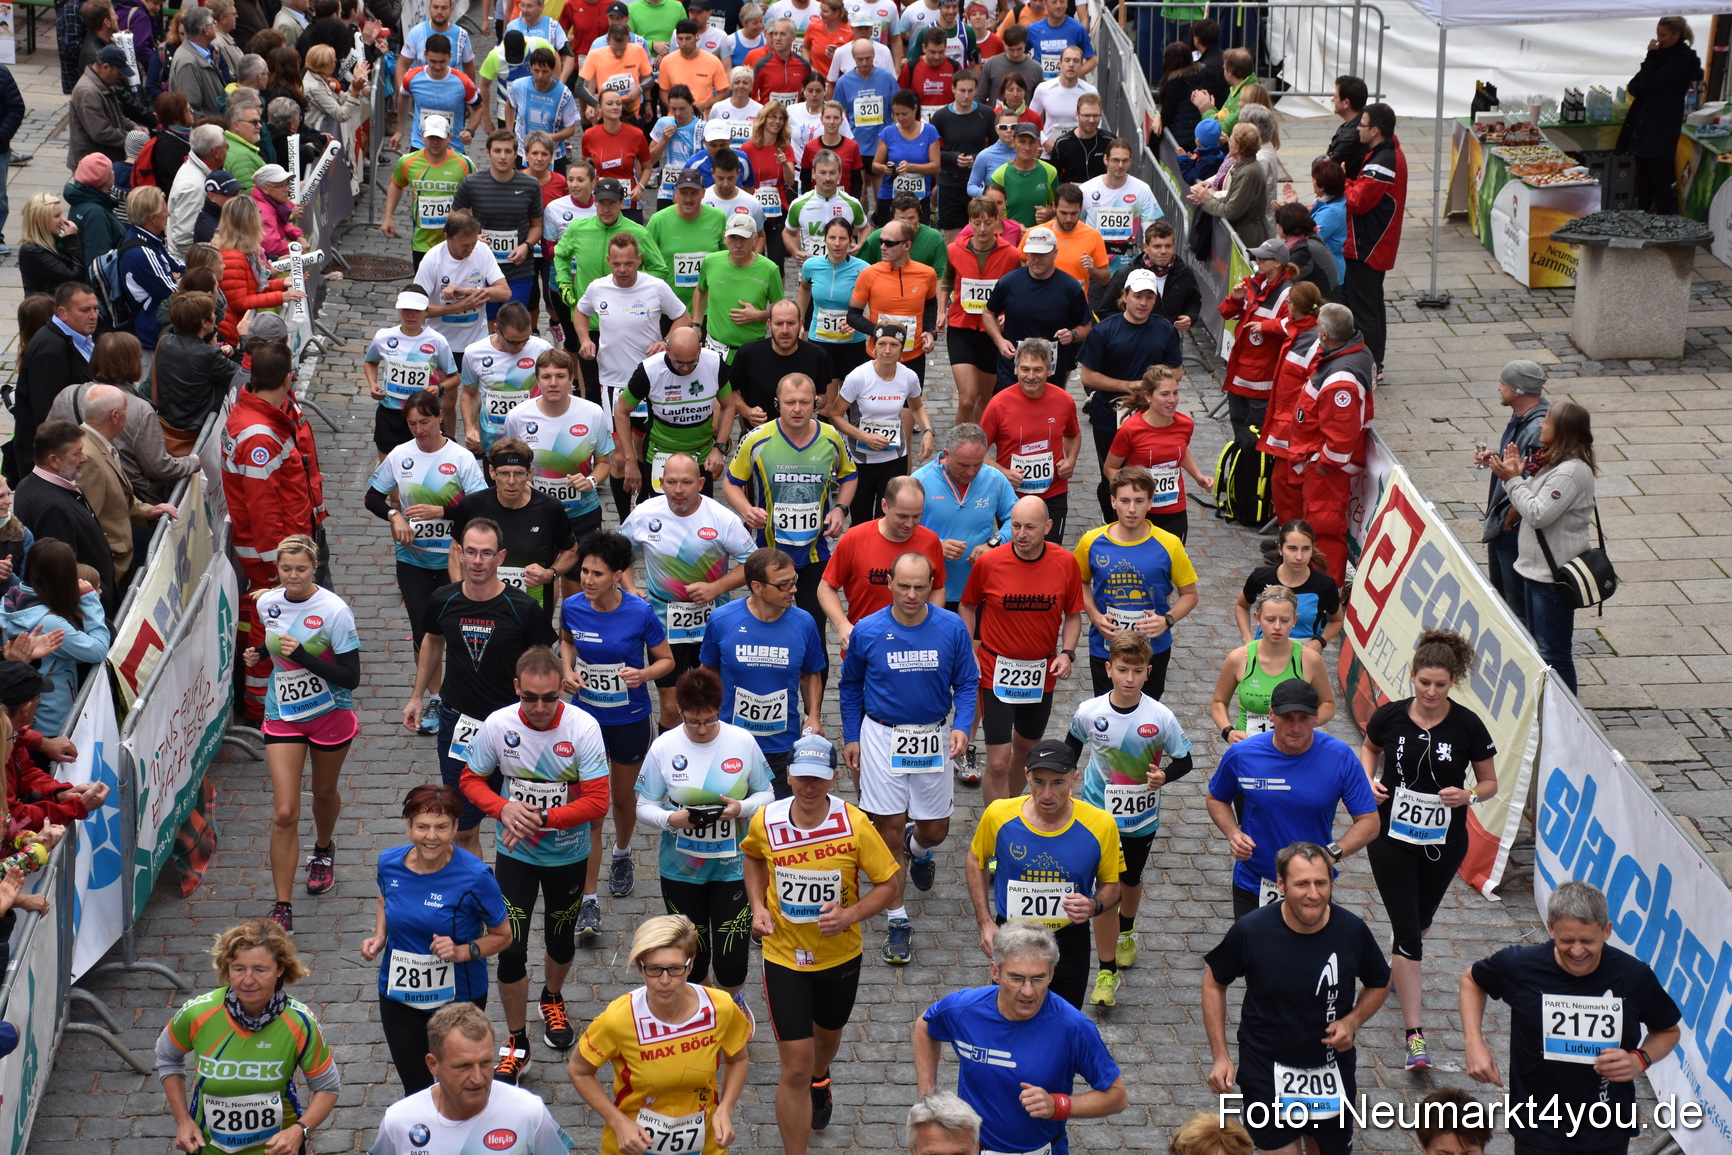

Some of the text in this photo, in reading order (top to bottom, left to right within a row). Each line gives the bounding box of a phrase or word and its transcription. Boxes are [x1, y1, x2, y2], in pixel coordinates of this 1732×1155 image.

[1040, 40, 1067, 49] HUBER
[1044, 61, 1060, 72] 254
[606, 79, 631, 92] 2587
[860, 103, 879, 116] 320
[730, 126, 750, 138] 646
[316, 158, 333, 179] BMW
[665, 171, 681, 184] 257
[413, 181, 460, 192] BOCK
[896, 178, 922, 192] 2359
[756, 194, 780, 206] 2553
[422, 203, 451, 217] 2794
[1101, 215, 1130, 228] 2692
[486, 238, 515, 252] 2601
[812, 244, 827, 256] 21
[292, 256, 302, 279] BMW
[678, 261, 701, 274] 274
[969, 288, 993, 301] 120
[391, 368, 426, 386] 2182
[491, 400, 521, 415] 239
[662, 404, 710, 416] Laufteam
[673, 415, 702, 423] Fürth
[1015, 463, 1051, 480] 2206
[773, 473, 824, 484] BOCK
[779, 513, 818, 530] 3116
[415, 521, 454, 539] 2394
[459, 618, 496, 627] FINISHER
[672, 608, 712, 628] 2256
[462, 625, 492, 634] BRAVEHEART
[736, 645, 790, 660] HUBER
[886, 649, 939, 663] HUBER
[746, 655, 788, 664] TECHNOLOGY
[899, 660, 938, 668] TECHNOLOGY
[996, 660, 1015, 668] PARTL
[1368, 627, 1412, 700] PFLA
[580, 670, 620, 692] 2551
[998, 668, 1043, 687] 2239
[279, 676, 324, 702] 2528
[1004, 688, 1032, 698] Michael
[588, 692, 614, 702] Claudia
[737, 692, 754, 700] PARTL
[290, 701, 319, 713] Yvonne
[739, 700, 782, 721] 2672
[743, 721, 775, 731] Matthias
[893, 728, 912, 736] PARTL
[896, 735, 940, 755] 2310
[503, 749, 521, 757] PARTL
[724, 762, 742, 770] Hervis
[902, 757, 933, 767] Bernhard
[512, 781, 558, 794] PARTL Neumarkt
[1111, 792, 1156, 815] 2466
[1396, 801, 1446, 827] 2670
[1408, 825, 1429, 839] Katja
[686, 840, 723, 852] ALEX
[772, 842, 857, 867] MAX BÖGL
[776, 872, 830, 882] PARTL Neumarkt
[781, 880, 836, 903] 2705
[1008, 886, 1063, 894] PARTL Neumarkt
[430, 893, 443, 901] TSG
[1020, 895, 1062, 917] 207
[392, 955, 443, 967] PARTL Neumarkt
[395, 965, 449, 989] 2817
[404, 992, 440, 1003] Barbara
[1544, 1000, 1610, 1011] PARTL Neumarkt
[1551, 1011, 1616, 1039] 2173
[640, 1034, 718, 1062] MAX BÖGL
[1565, 1042, 1601, 1056] Ludwig
[198, 1056, 285, 1081] BOCK
[1282, 1070, 1338, 1096] 2209
[205, 1098, 269, 1108] PARTL Neumarkt
[211, 1108, 277, 1132] 2808
[639, 1112, 694, 1130] PARTL Neumarkt
[226, 1133, 261, 1146] Margit
[488, 1134, 514, 1145] Hervis
[643, 1126, 700, 1153] 2757
